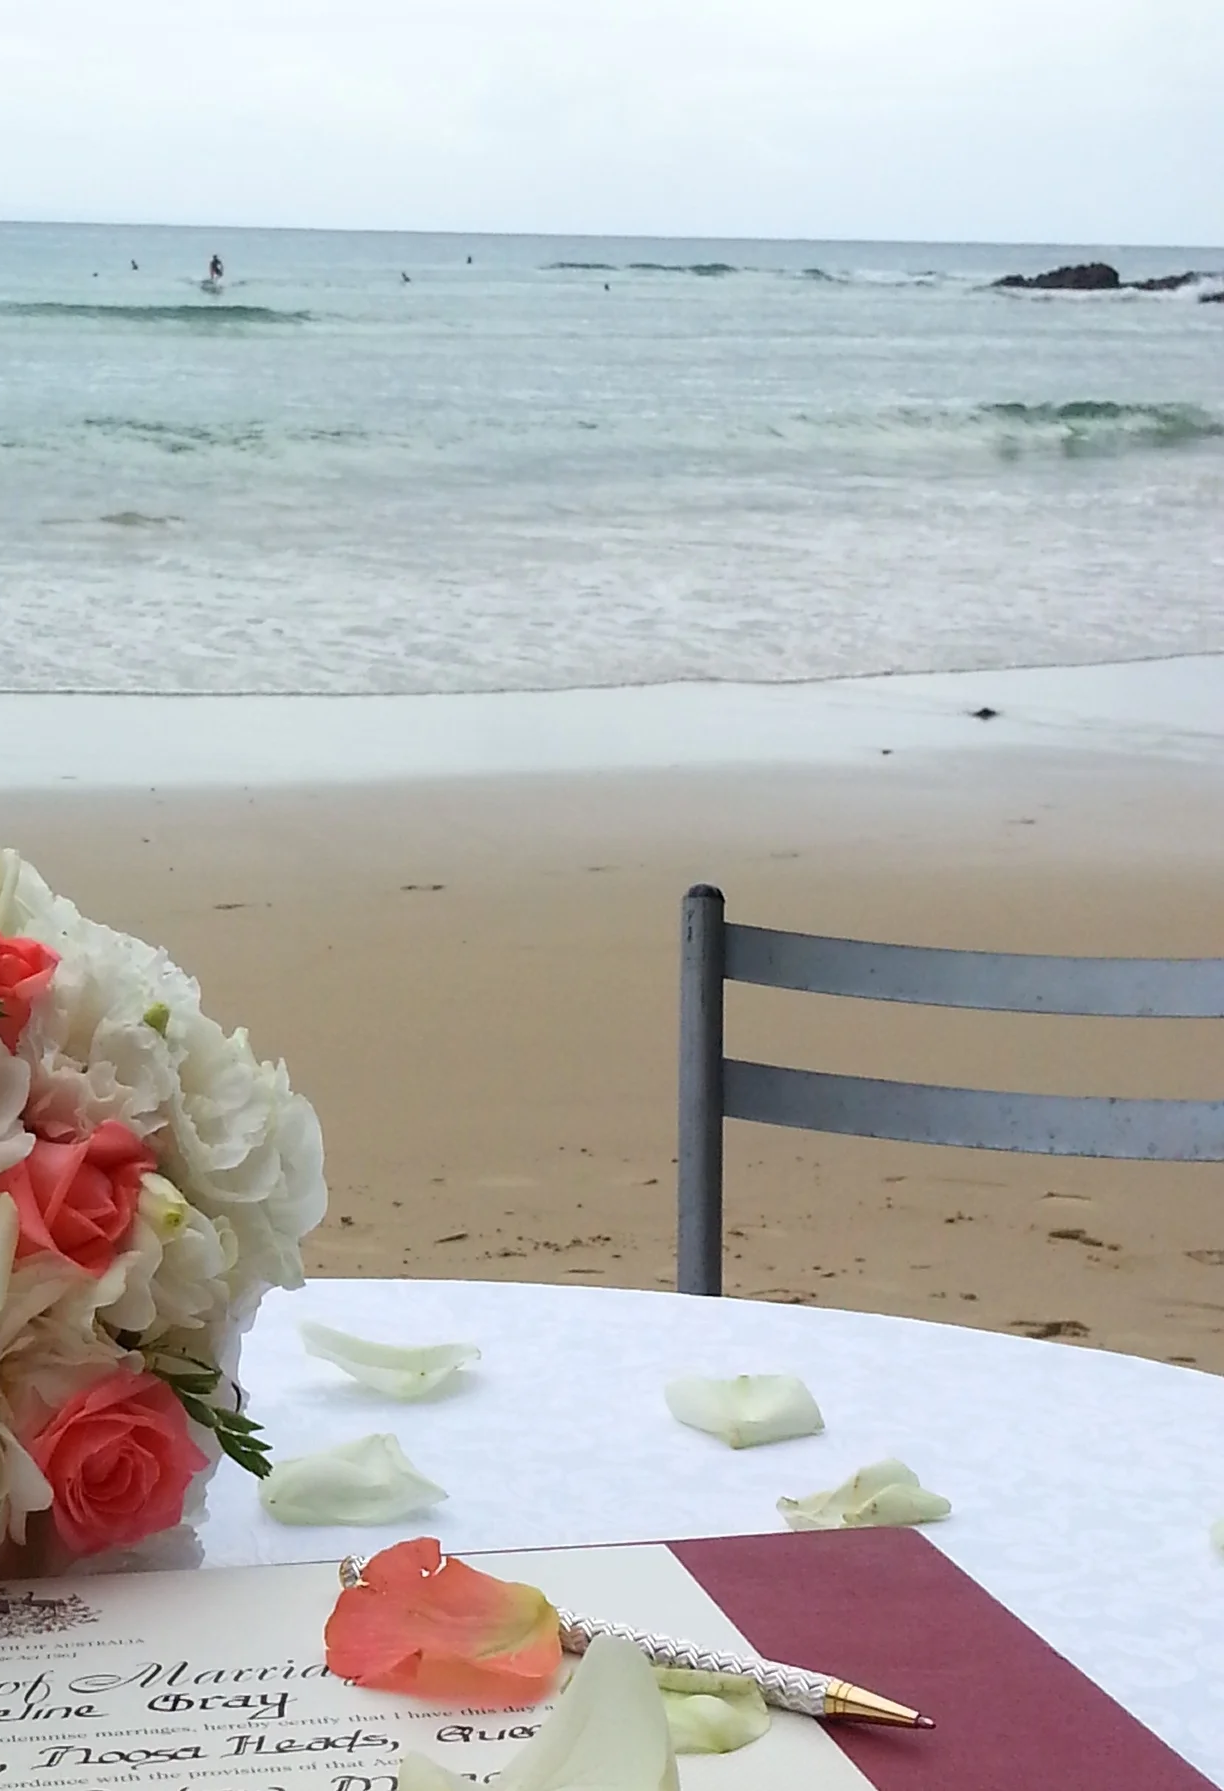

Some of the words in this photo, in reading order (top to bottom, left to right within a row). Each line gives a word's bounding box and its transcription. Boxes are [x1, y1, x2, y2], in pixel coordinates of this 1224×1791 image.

[26, 1643, 47, 1651] OF
[54, 1638, 145, 1649] AUSTRALIA
[68, 1659, 357, 1694] Marria
[95, 1724, 197, 1739] marriages,
[204, 1719, 270, 1733] hereby
[278, 1714, 340, 1727] certify
[349, 1712, 386, 1723] that
[394, 1711, 400, 1720] I
[407, 1709, 452, 1720] have
[460, 1706, 497, 1717] this
[503, 1704, 535, 1714] day
[147, 1691, 298, 1721] Gray
[30, 1745, 208, 1771] Noosa
[219, 1728, 400, 1760] Heads,
[97, 1772, 141, 1784] with
[149, 1771, 181, 1781] the
[189, 1764, 293, 1780] provisions
[299, 1761, 317, 1771] of
[325, 1760, 365, 1769] that
